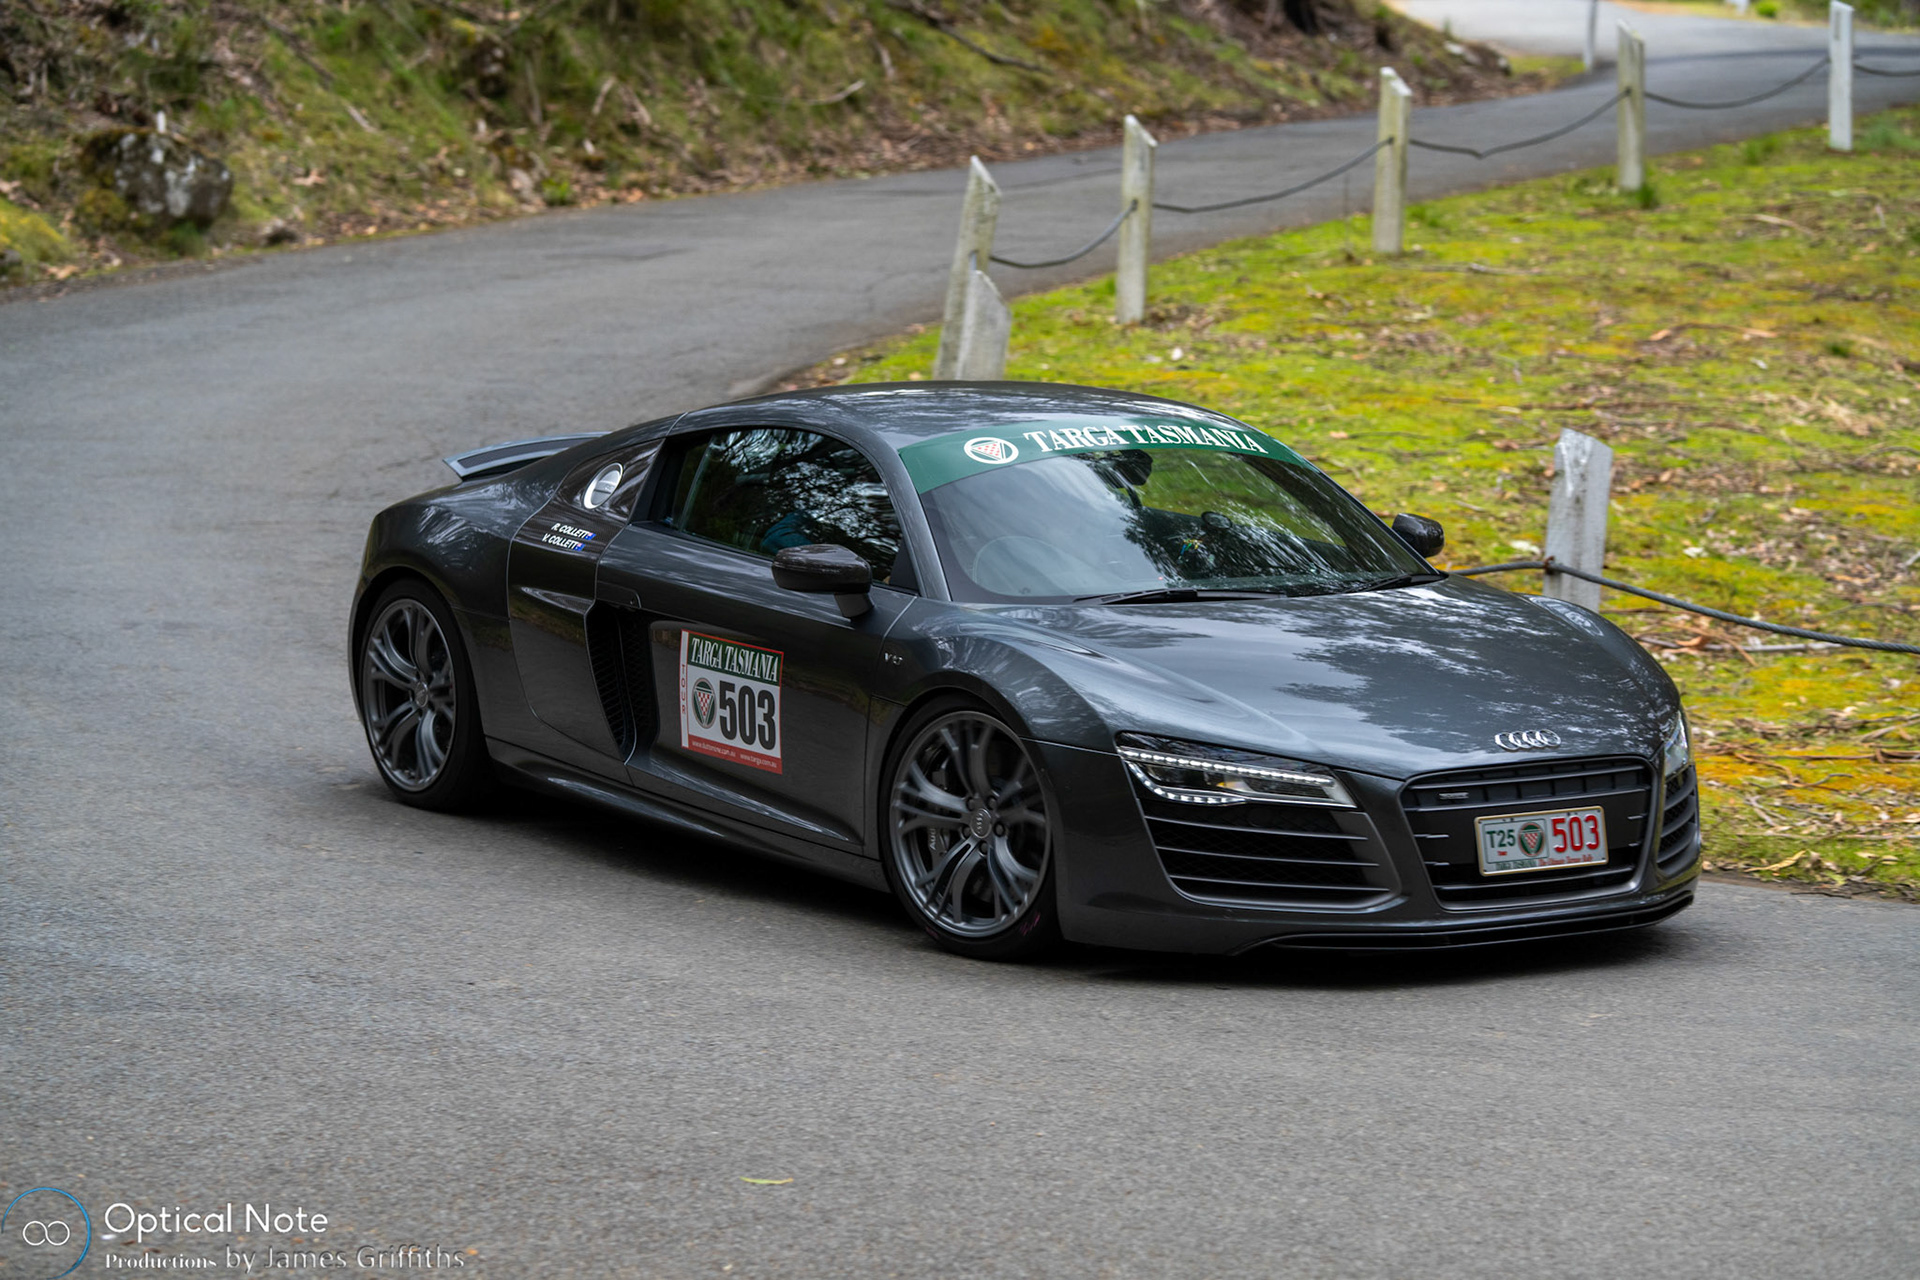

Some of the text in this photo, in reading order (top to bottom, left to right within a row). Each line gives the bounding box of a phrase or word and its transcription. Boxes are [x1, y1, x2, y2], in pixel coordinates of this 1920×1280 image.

[1023, 425, 1269, 454] TARGA TASMANIA
[548, 536, 578, 549] COLLETT
[559, 525, 588, 539] COLLETT
[690, 637, 779, 682] TARGA TASMANIA
[719, 680, 776, 750] 503
[1486, 829, 1516, 849] T25
[1551, 815, 1600, 853] 503
